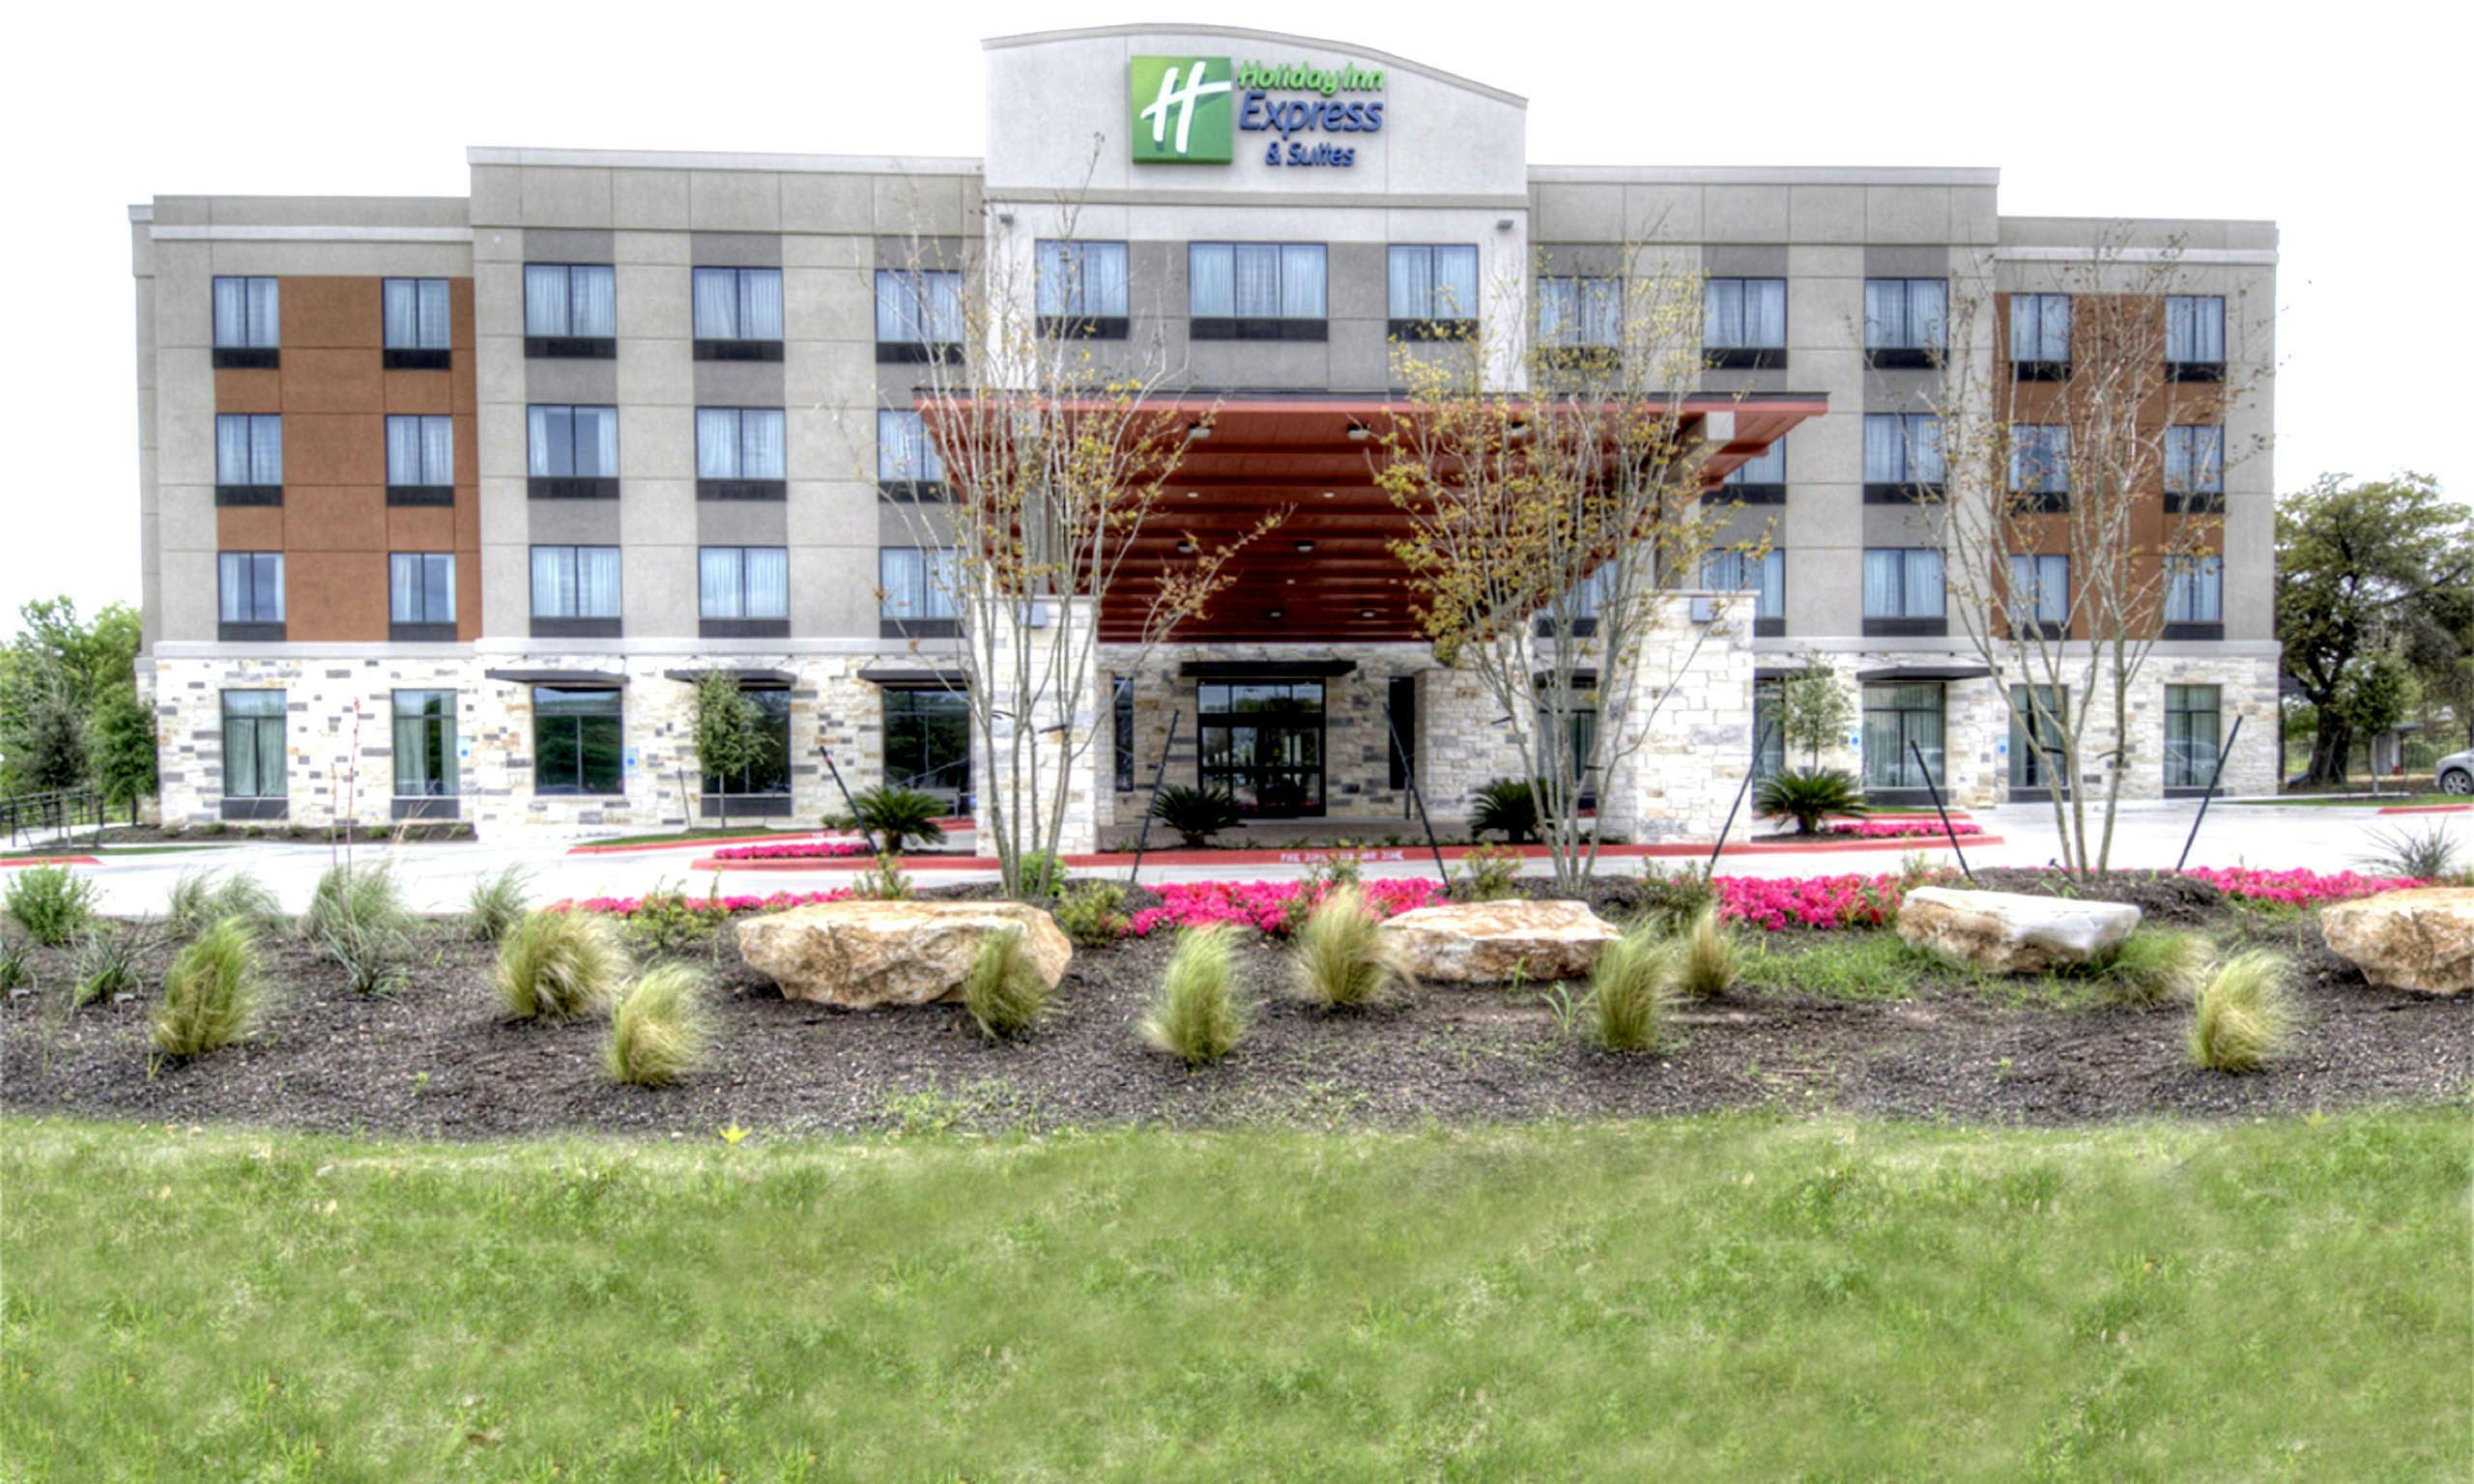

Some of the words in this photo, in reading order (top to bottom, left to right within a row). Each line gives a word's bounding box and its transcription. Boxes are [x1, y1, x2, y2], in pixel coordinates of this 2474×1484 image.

[1238, 60, 1339, 97] Holiday
[1342, 61, 1385, 91] Inn
[1239, 91, 1384, 141] Express
[1265, 141, 1281, 166] &
[1286, 141, 1356, 166] Suites
